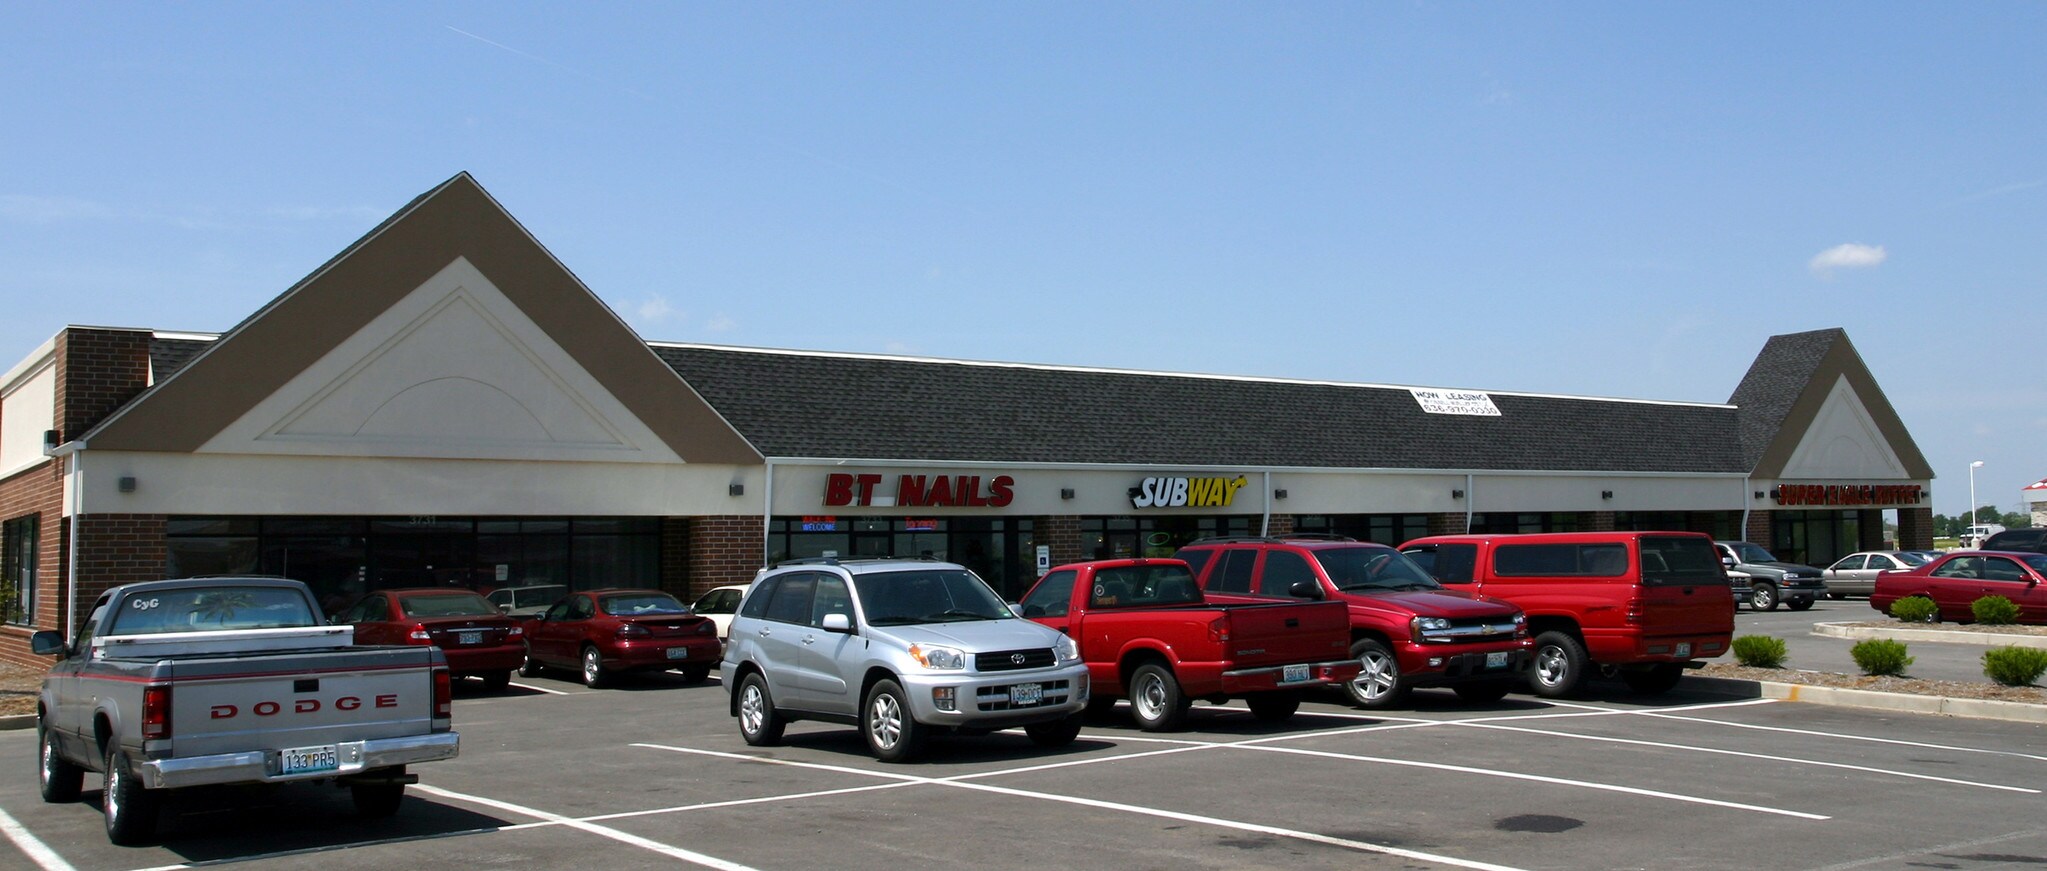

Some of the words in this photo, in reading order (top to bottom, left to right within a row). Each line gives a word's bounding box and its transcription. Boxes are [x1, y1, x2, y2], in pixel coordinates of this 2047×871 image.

[1445, 392, 1488, 401] LEASING
[823, 473, 882, 507] BT
[898, 475, 1015, 508] NAILS
[1130, 475, 1248, 508] SUBWAY
[1777, 484, 1826, 506] SUPER
[802, 523, 836, 531] WELCOME
[133, 598, 159, 610] CyG
[211, 694, 398, 720] DODGE
[286, 753, 309, 770] 133
[312, 751, 336, 768] PR5
